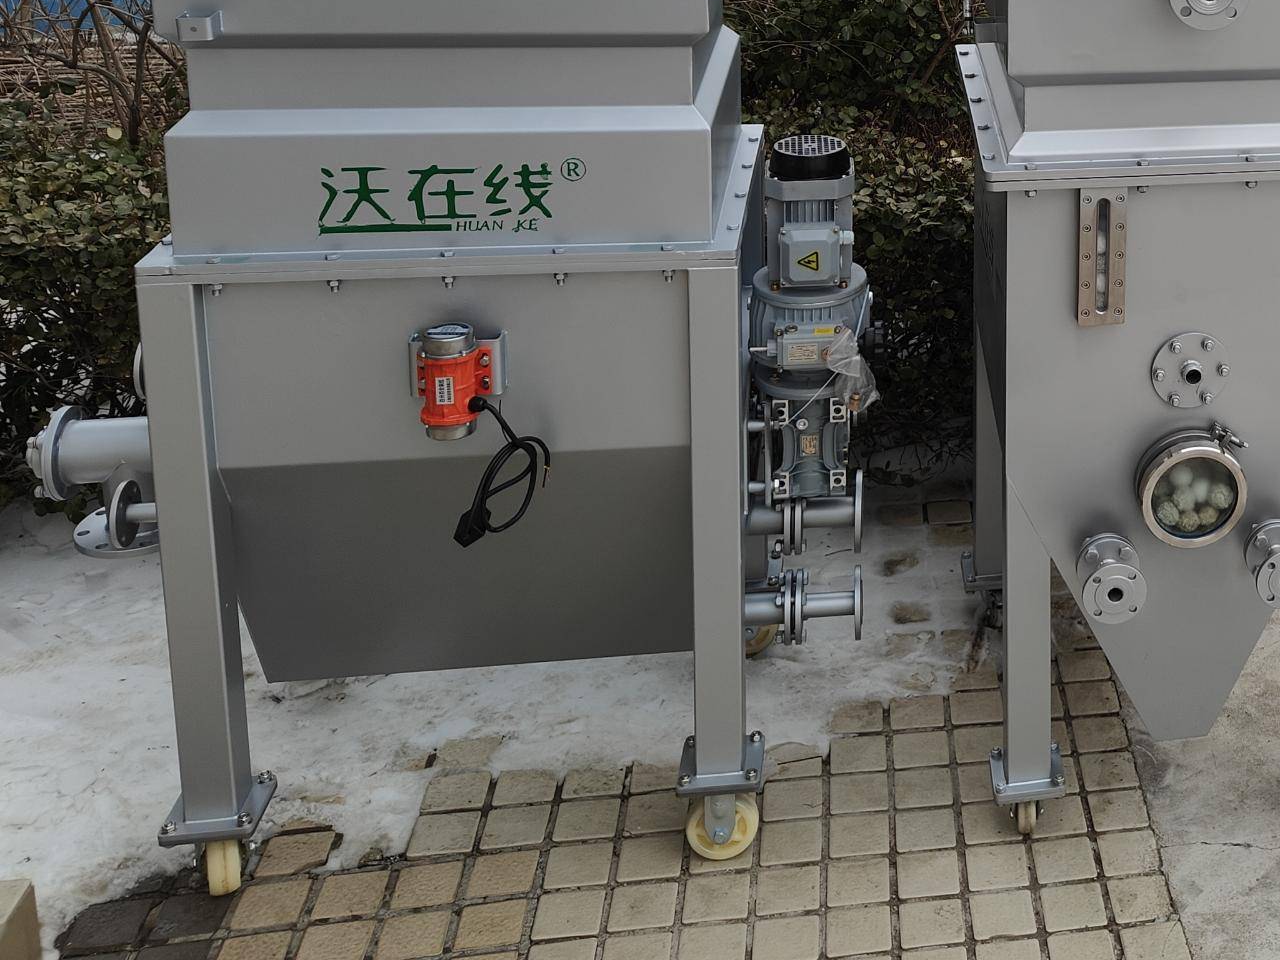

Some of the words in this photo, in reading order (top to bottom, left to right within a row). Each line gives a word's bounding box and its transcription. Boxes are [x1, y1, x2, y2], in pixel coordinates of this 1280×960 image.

[318, 163, 553, 226] 沃在线
[455, 219, 504, 233] HUAN
[512, 218, 540, 233] KE
